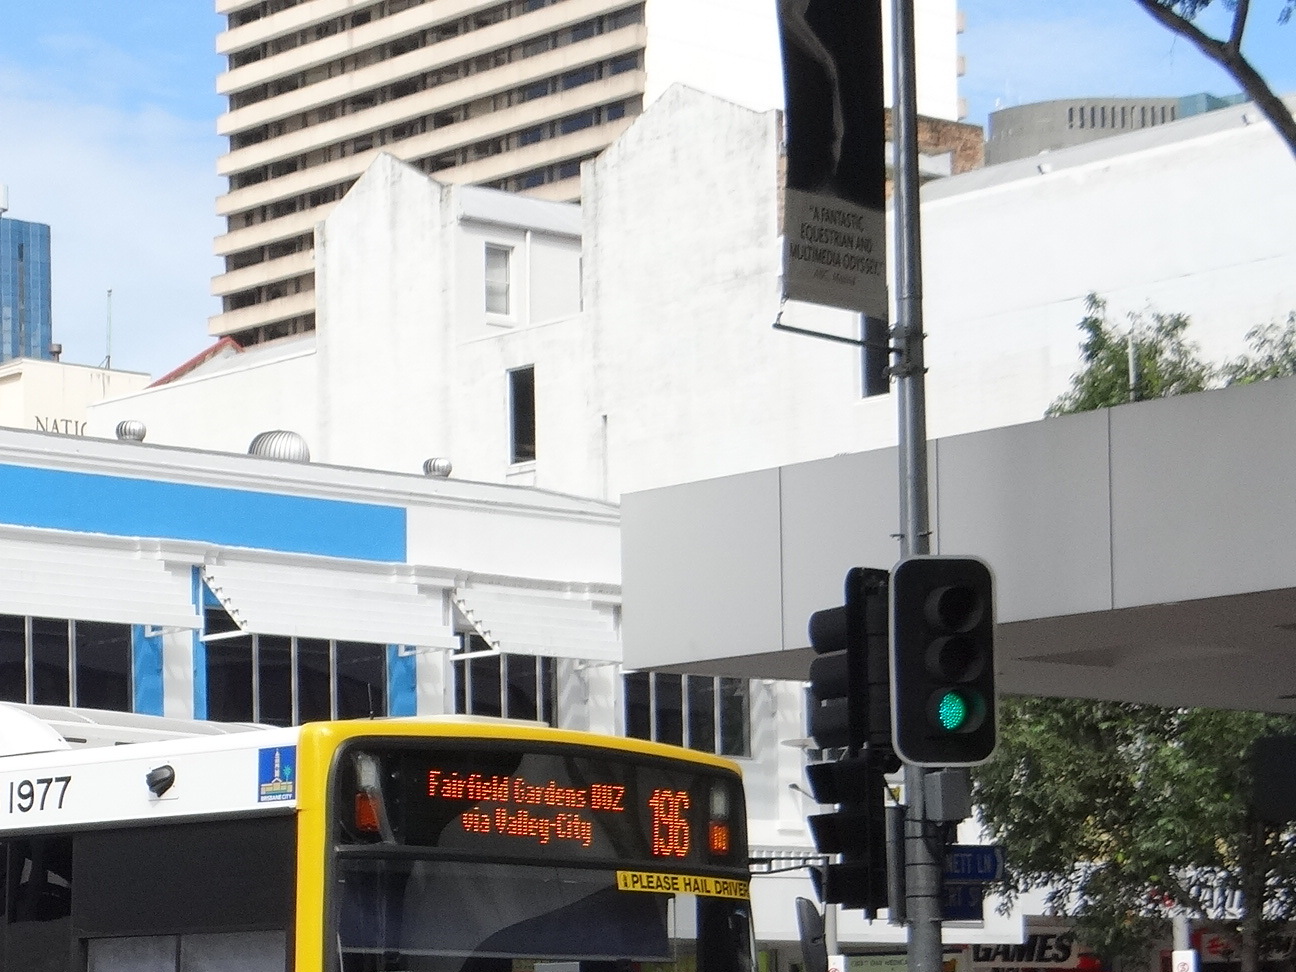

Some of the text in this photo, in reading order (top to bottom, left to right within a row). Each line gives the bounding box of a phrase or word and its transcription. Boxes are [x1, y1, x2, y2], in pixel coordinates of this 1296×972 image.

[9, 776, 71, 814] 1977
[429, 770, 508, 801] Fairfield
[514, 778, 586, 807] Gardens
[462, 807, 591, 847] via Valley-City
[649, 789, 689, 857] 196
[631, 874, 680, 891] PLEASE
[684, 877, 711, 893] HAIL
